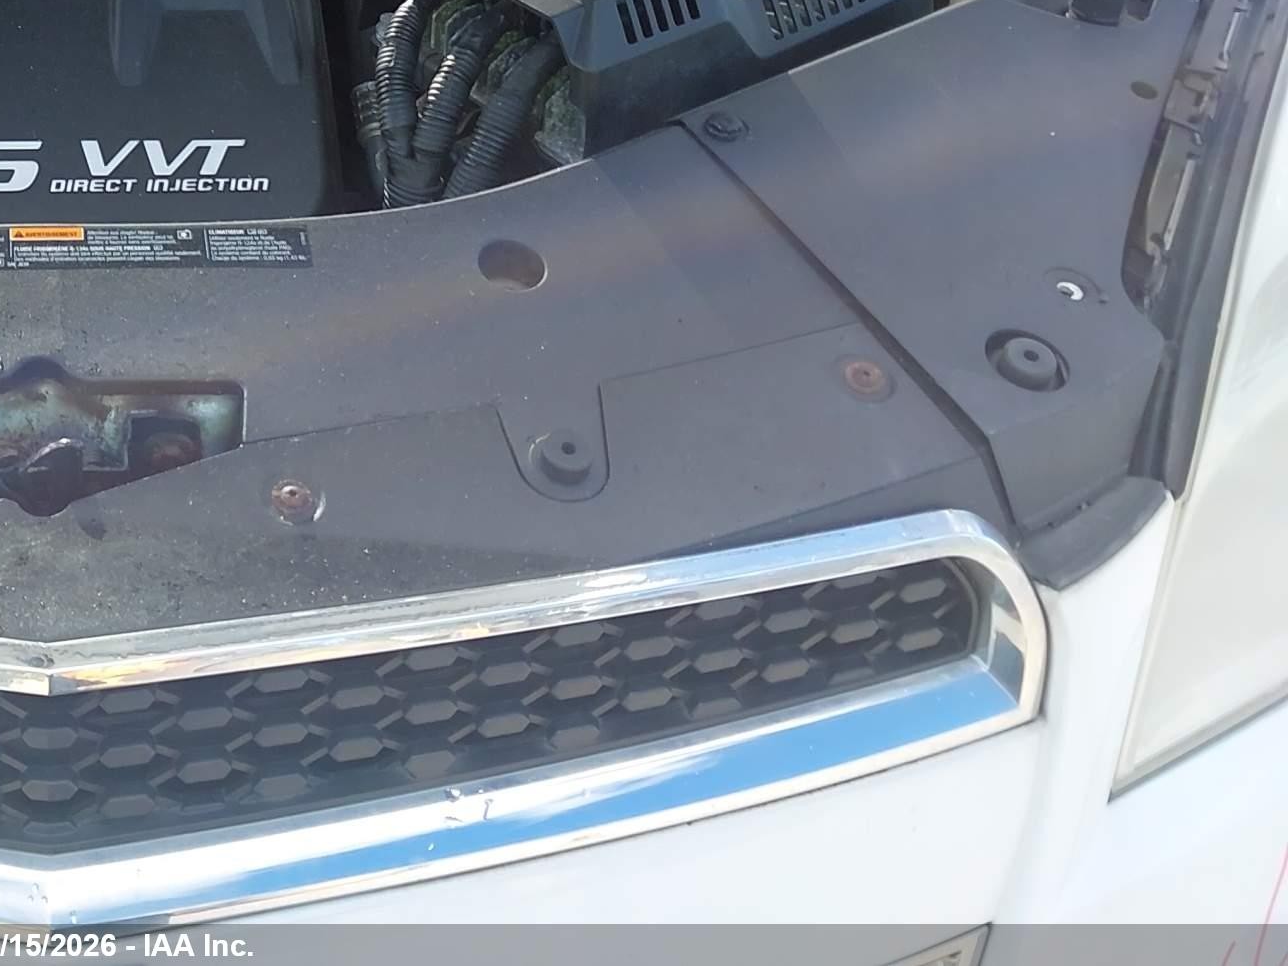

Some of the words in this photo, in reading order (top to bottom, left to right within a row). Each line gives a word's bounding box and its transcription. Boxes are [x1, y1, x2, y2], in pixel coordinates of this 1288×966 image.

[80, 139, 246, 176] VVT
[49, 178, 137, 193] DIRECT
[146, 177, 270, 193] INJECTION
